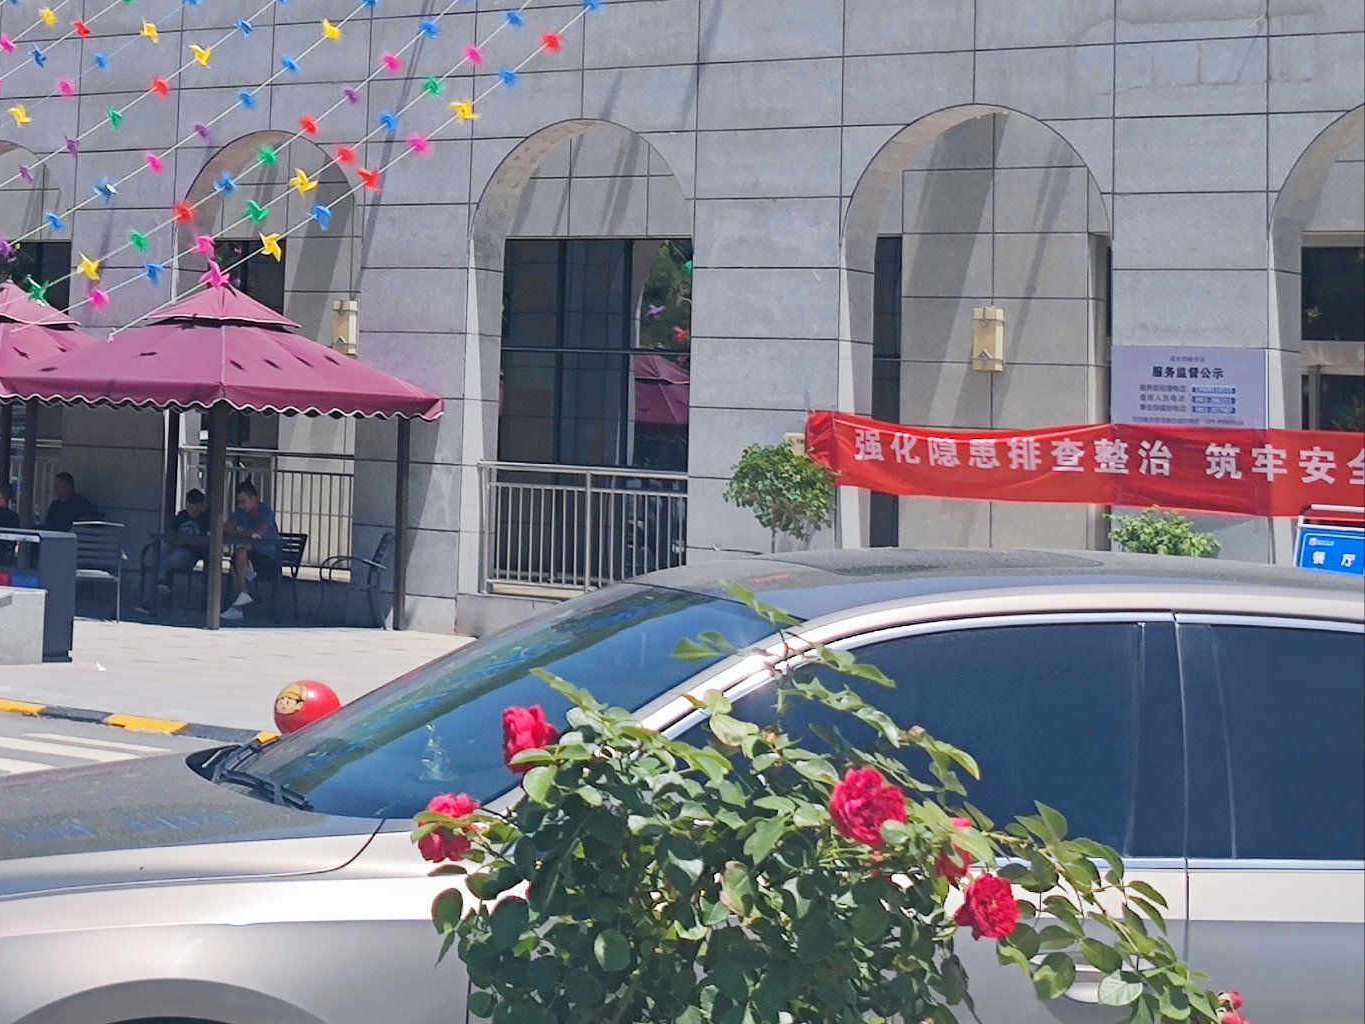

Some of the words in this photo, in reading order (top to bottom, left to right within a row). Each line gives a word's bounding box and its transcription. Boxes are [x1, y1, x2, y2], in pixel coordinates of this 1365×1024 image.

[1152, 366, 1225, 380] 服务监督公示
[855, 428, 1174, 476] 强化隐患排查整治
